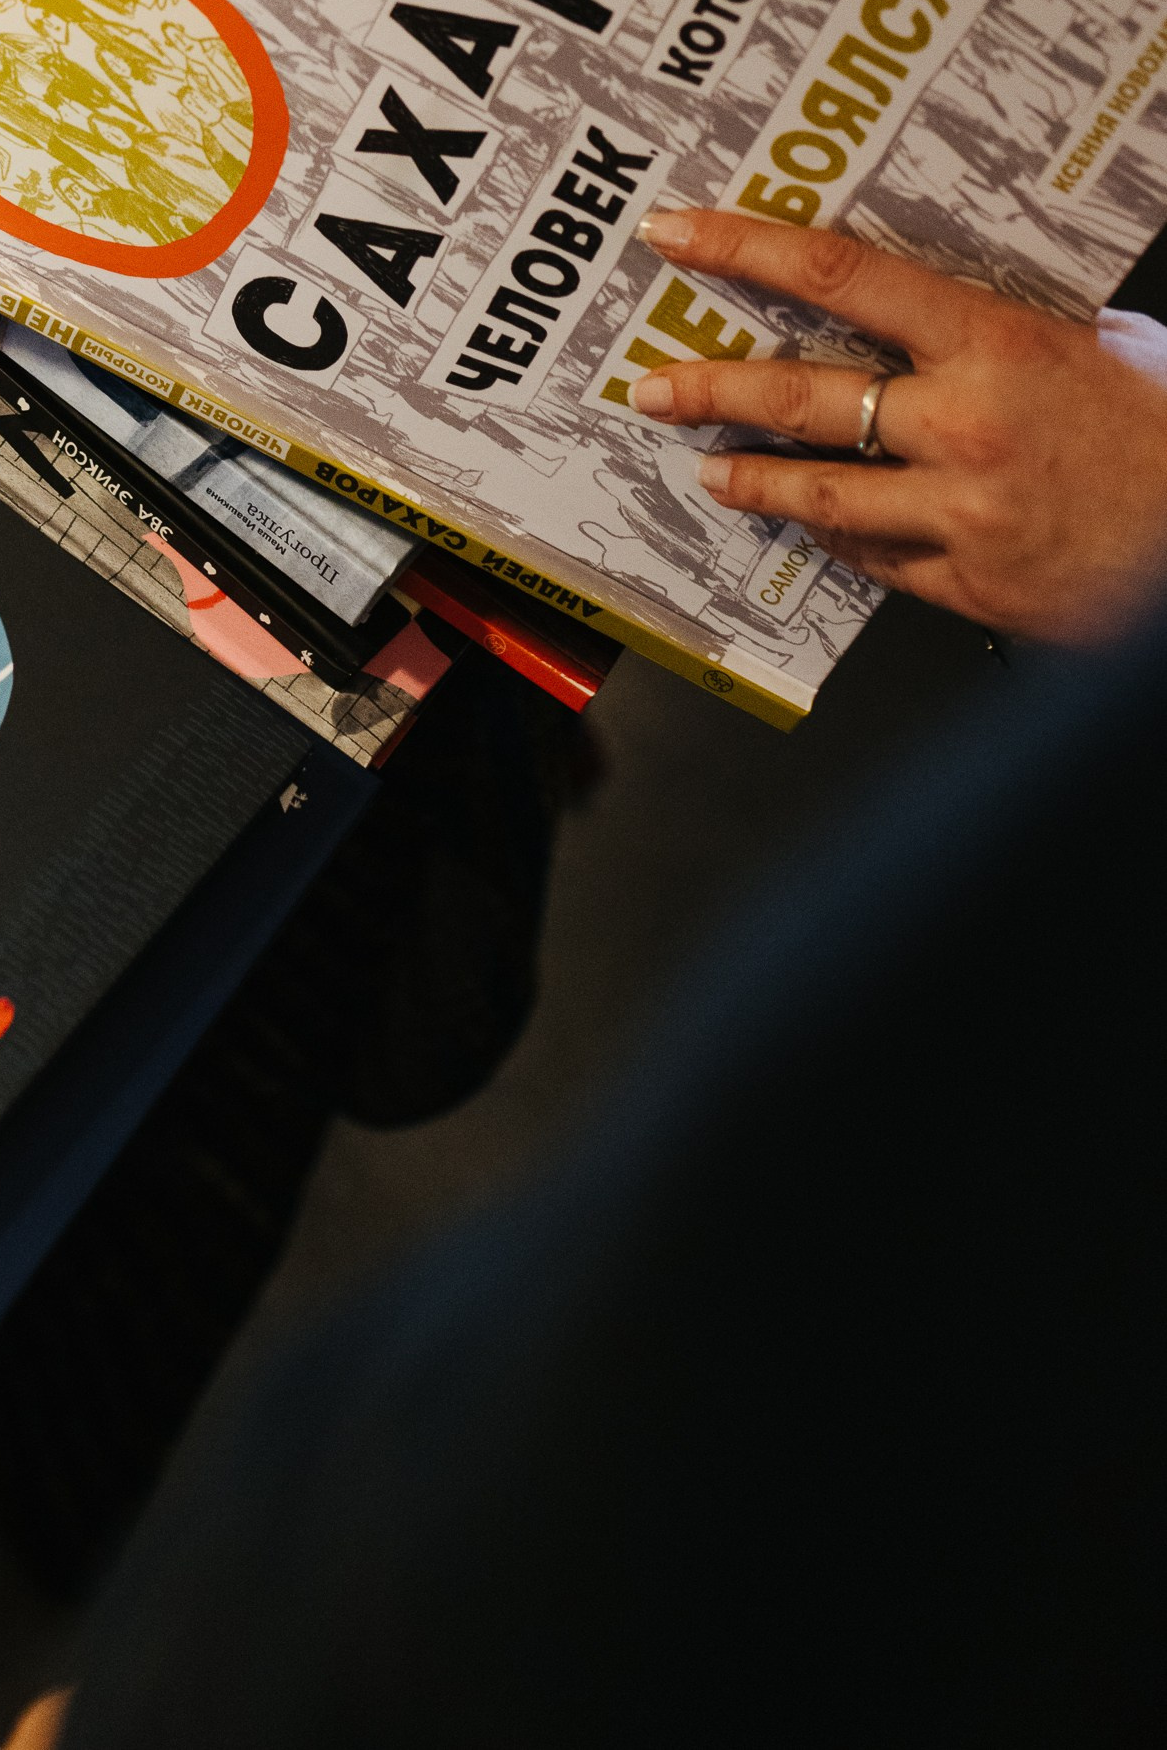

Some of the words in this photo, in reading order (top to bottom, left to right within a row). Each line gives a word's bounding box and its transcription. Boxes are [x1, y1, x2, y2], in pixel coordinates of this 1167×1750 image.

[1051, 111, 1120, 193] КСЕНИЯ
[29, 307, 74, 346] НЕ
[85, 340, 171, 392] КОТОРЫЙ
[52, 429, 133, 506] ЭРИКСОН
[138, 503, 174, 542] ЭВА
[206, 487, 256, 531] Ивашкина
[314, 461, 469, 550] САХАРОВ
[247, 502, 340, 585] Прогулка
[257, 527, 287, 555] Маша
[482, 549, 605, 619] АНДРЕЙ
